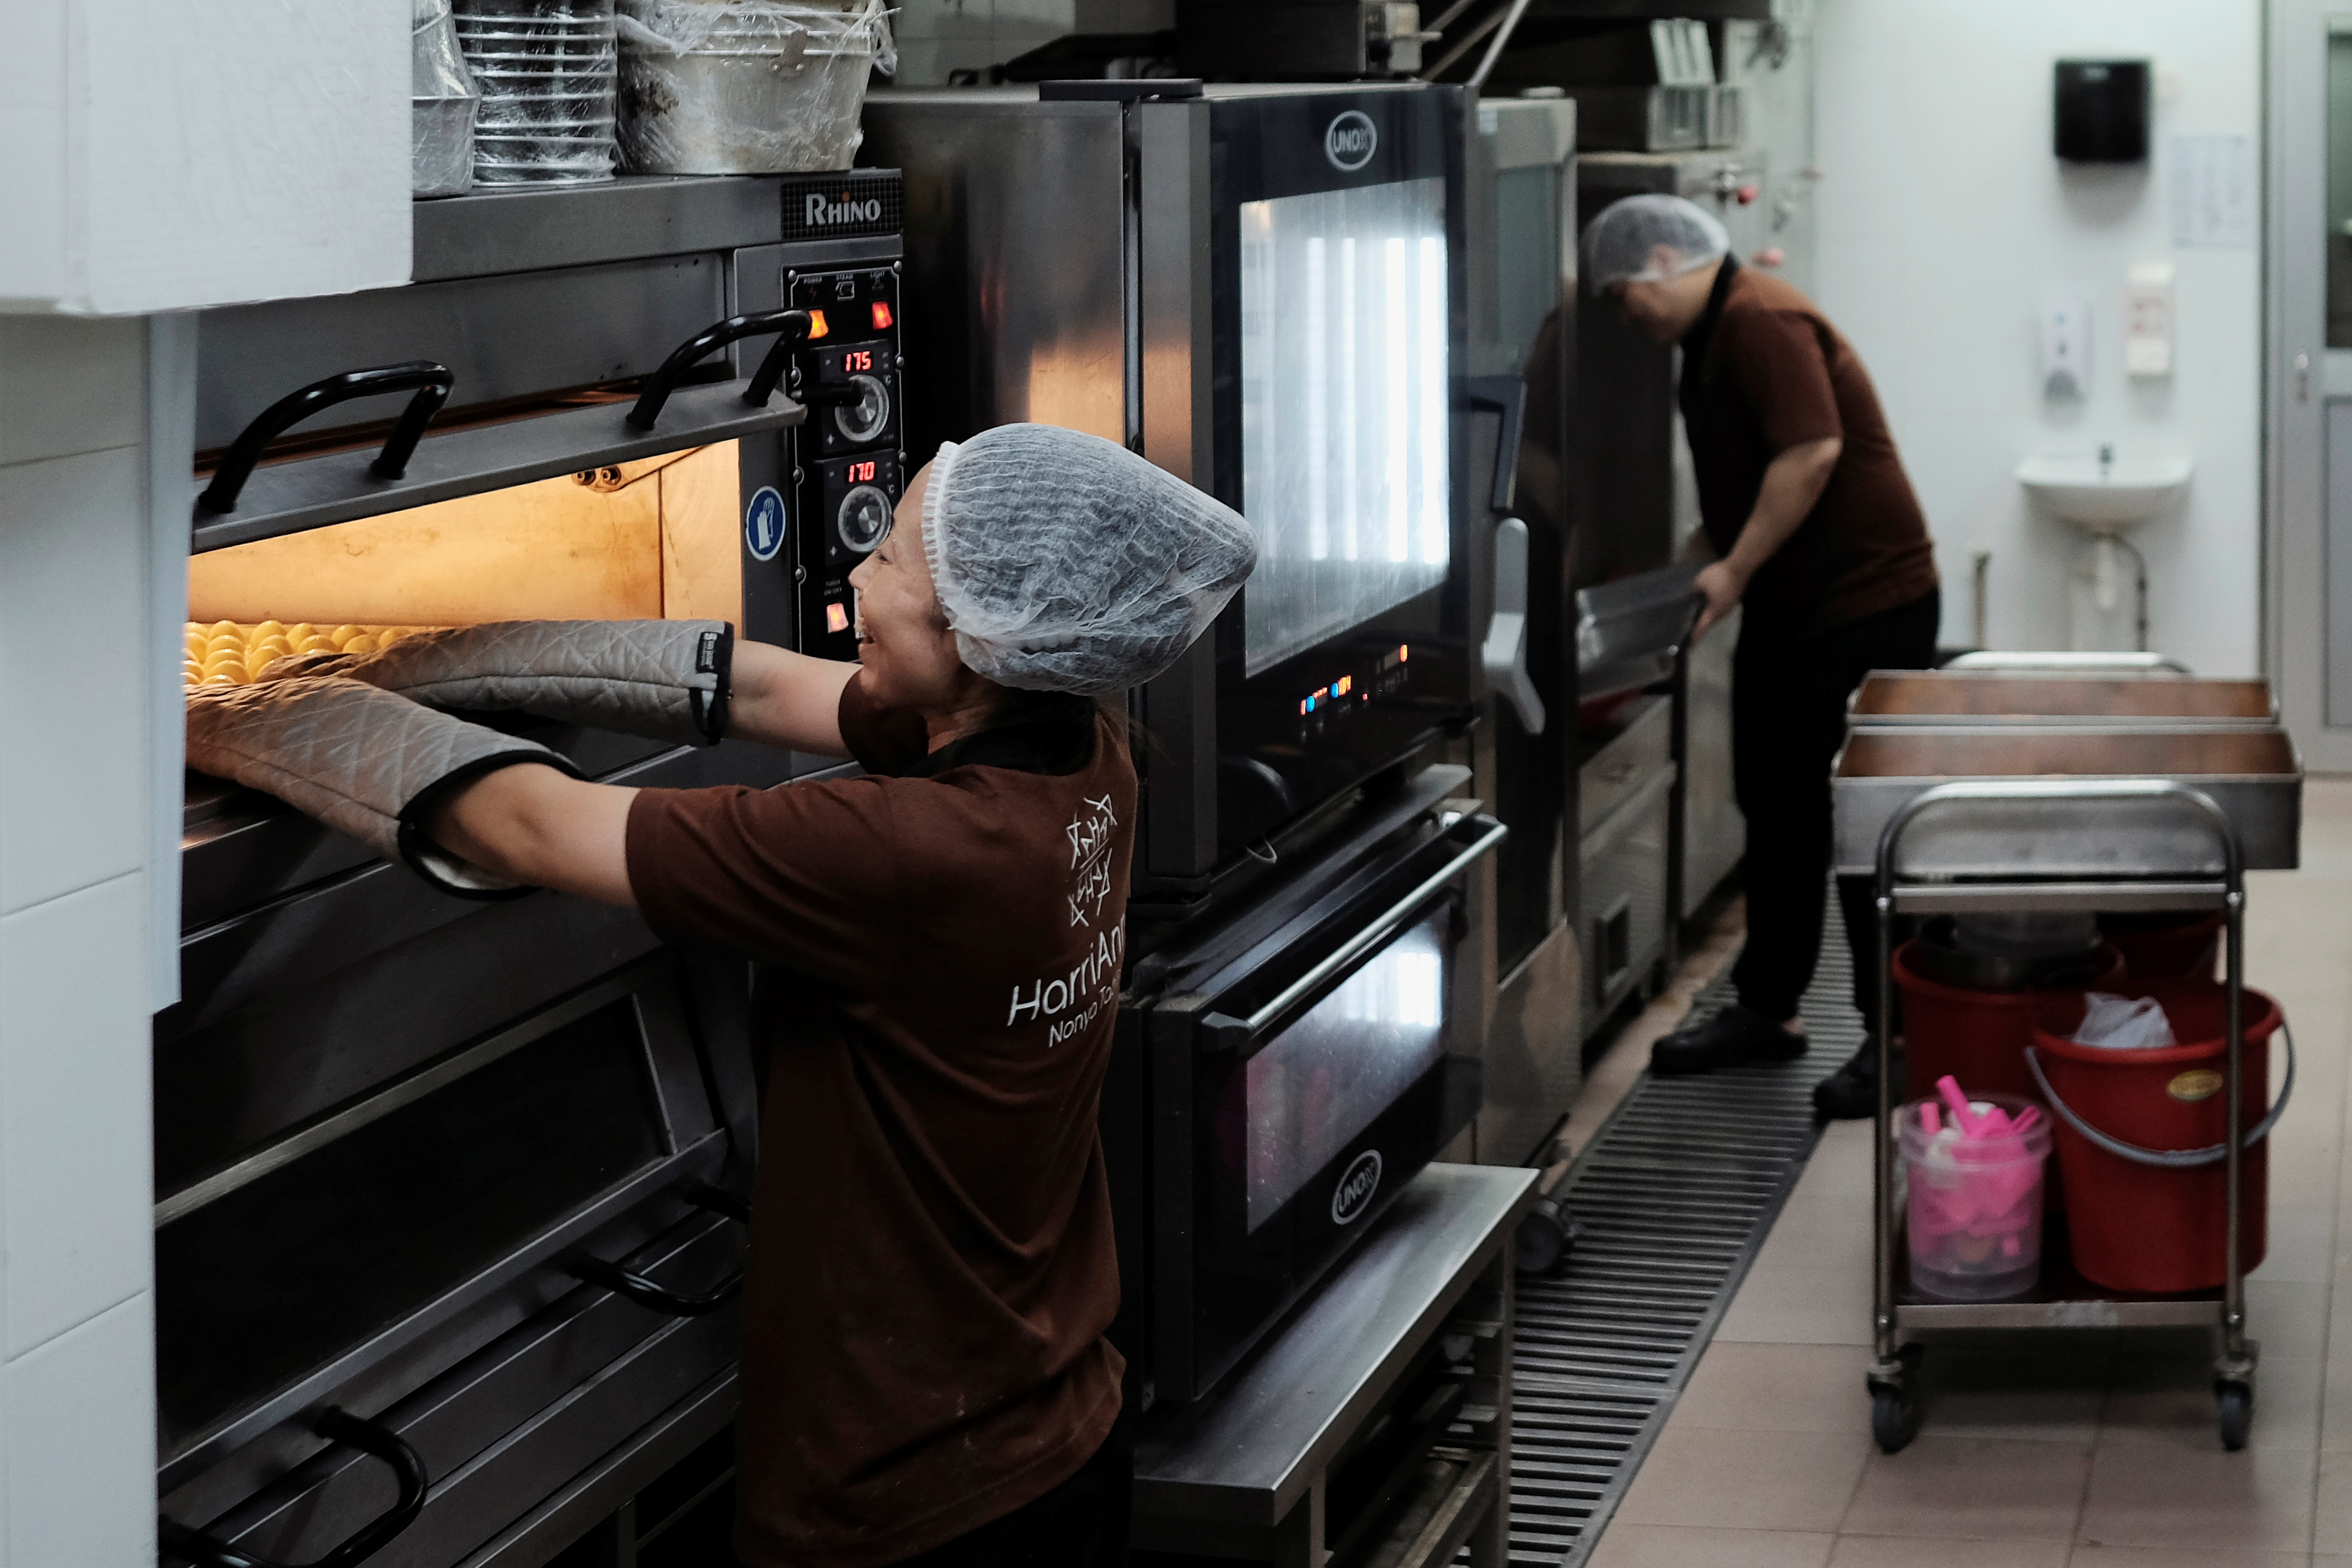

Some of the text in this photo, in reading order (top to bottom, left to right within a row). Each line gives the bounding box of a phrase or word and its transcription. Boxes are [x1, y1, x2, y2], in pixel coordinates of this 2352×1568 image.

[1333, 128, 1371, 153] UNOX
[845, 350, 872, 373] 175
[848, 461, 876, 483] 170
